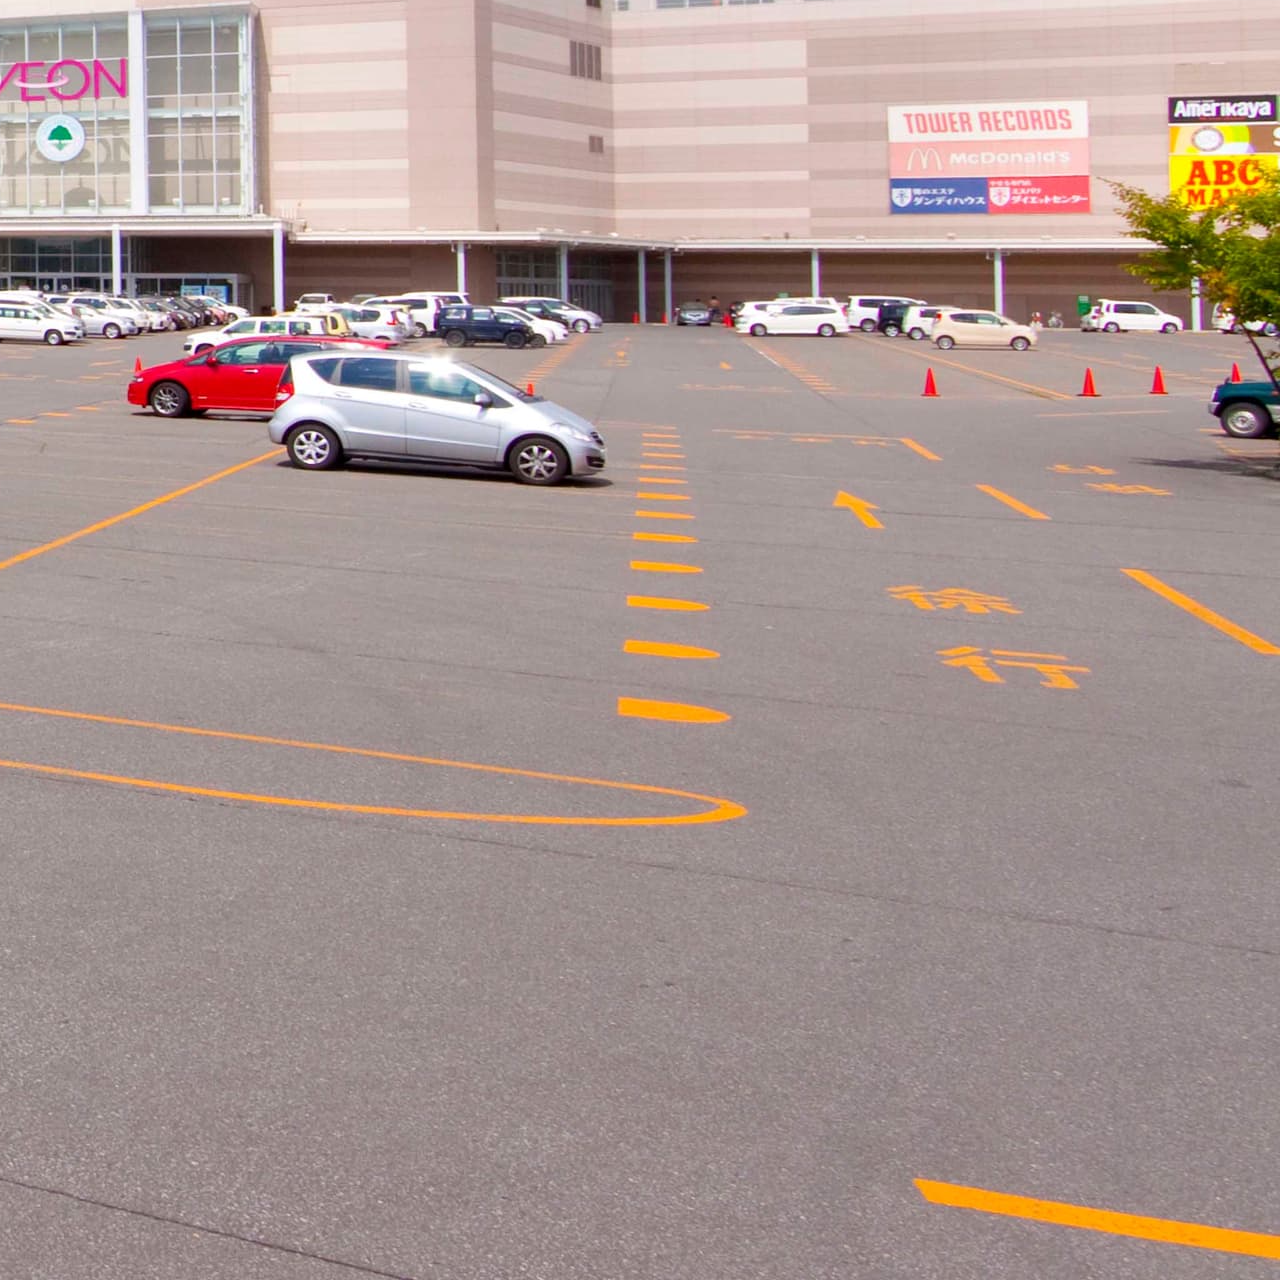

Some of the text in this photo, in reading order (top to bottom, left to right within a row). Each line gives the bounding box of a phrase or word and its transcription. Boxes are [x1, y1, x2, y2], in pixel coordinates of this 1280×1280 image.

[1174, 100, 1272, 119] Amerikaya
[903, 108, 1072, 134] TOWER RECORDS
[949, 150, 1071, 166] McDonald's
[1186, 159, 1260, 186] ABC
[912, 195, 987, 207] ダンディハウス
[1010, 194, 1089, 206] ダイエットセンター
